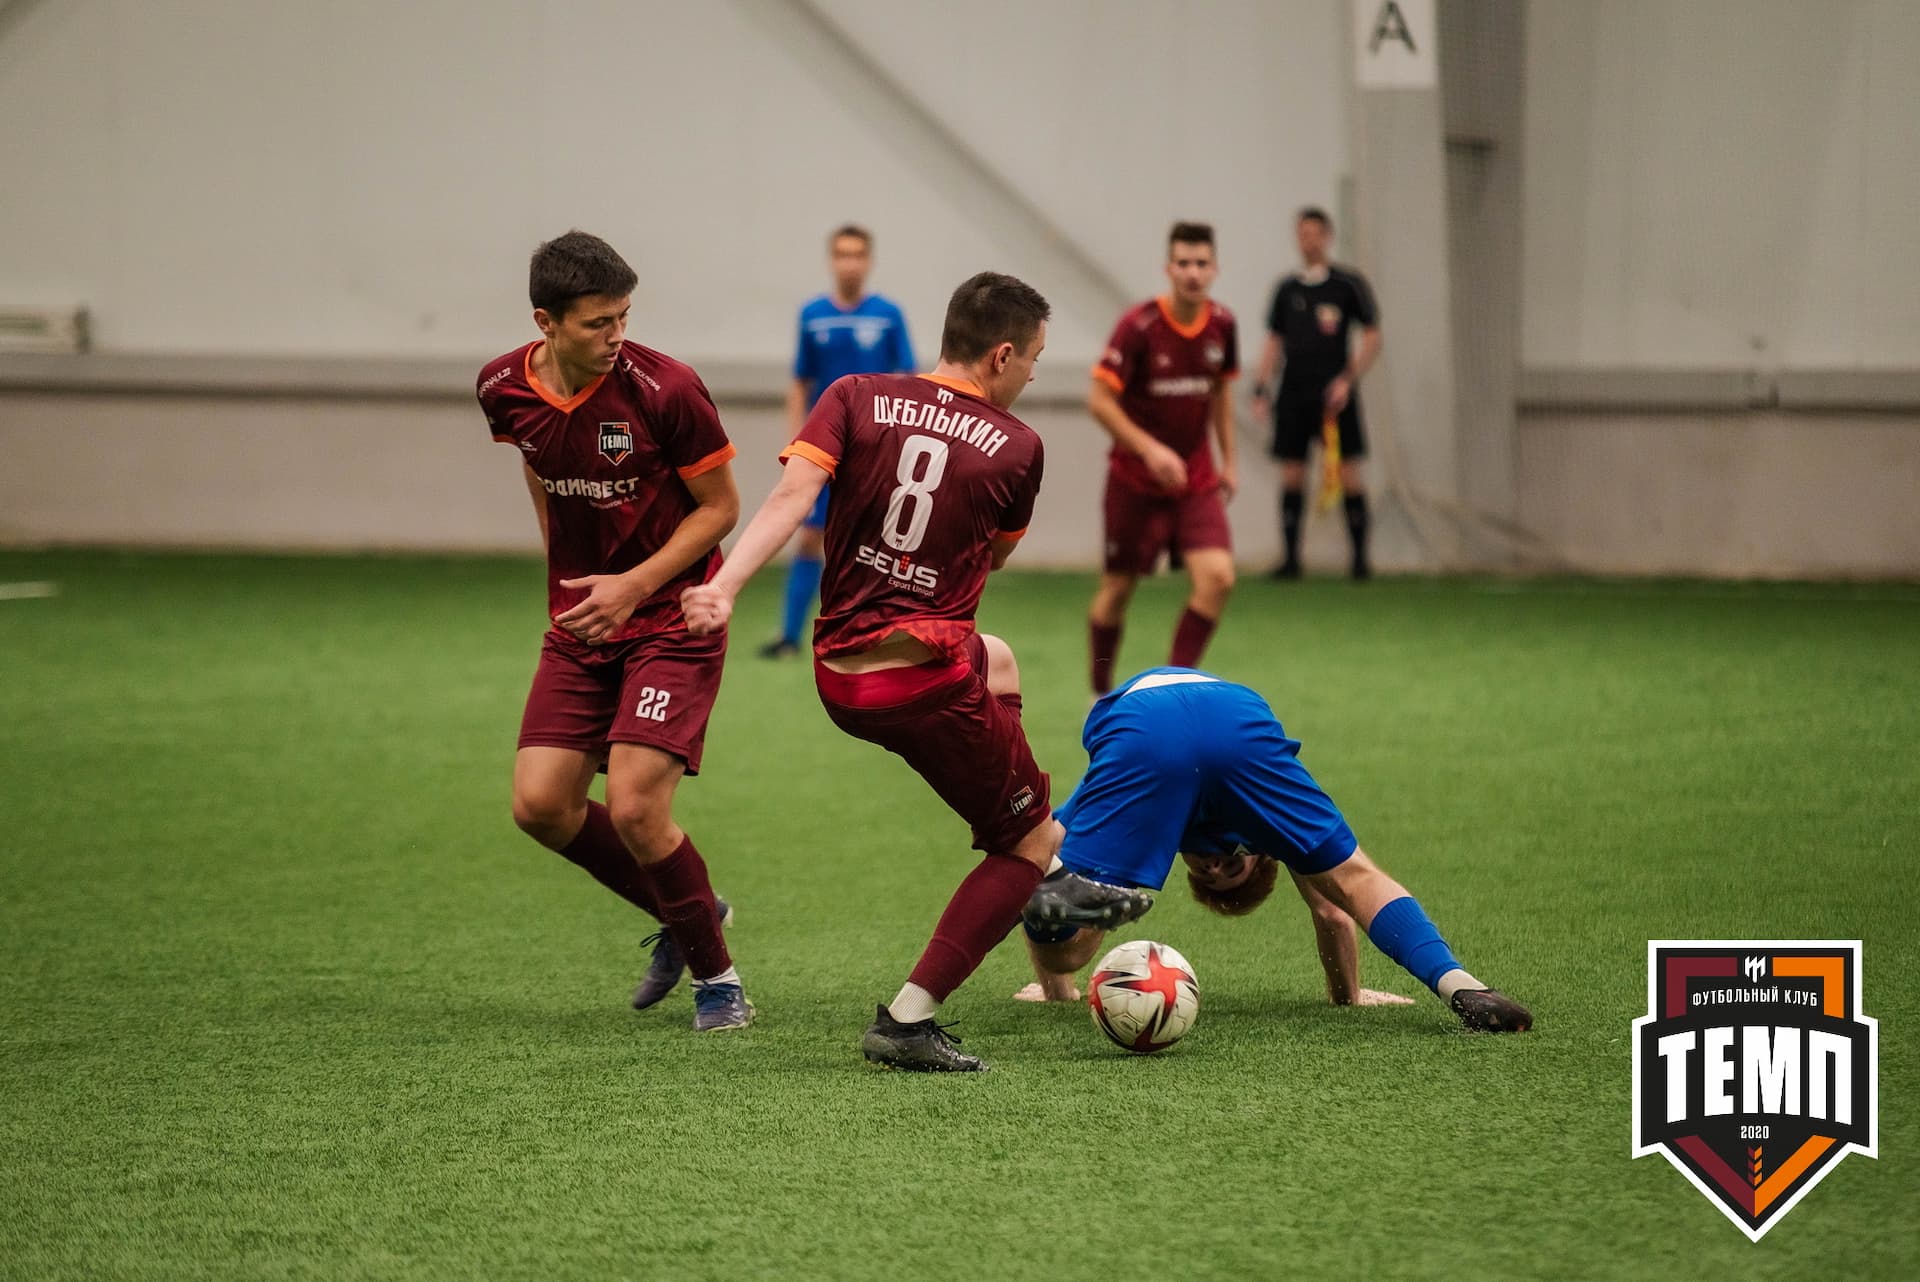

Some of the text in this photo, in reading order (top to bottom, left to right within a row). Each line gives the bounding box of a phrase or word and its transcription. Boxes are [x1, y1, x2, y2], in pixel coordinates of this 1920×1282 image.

[602, 434, 630, 450] ТЕМП
[874, 395, 1009, 457] ЩЕБЛЫКИН
[537, 477, 639, 499] ОДИНВЕСТ
[881, 434, 949, 552] 8
[855, 545, 939, 589] SEUS
[888, 577, 935, 598] Export Union
[635, 686, 671, 722] 22
